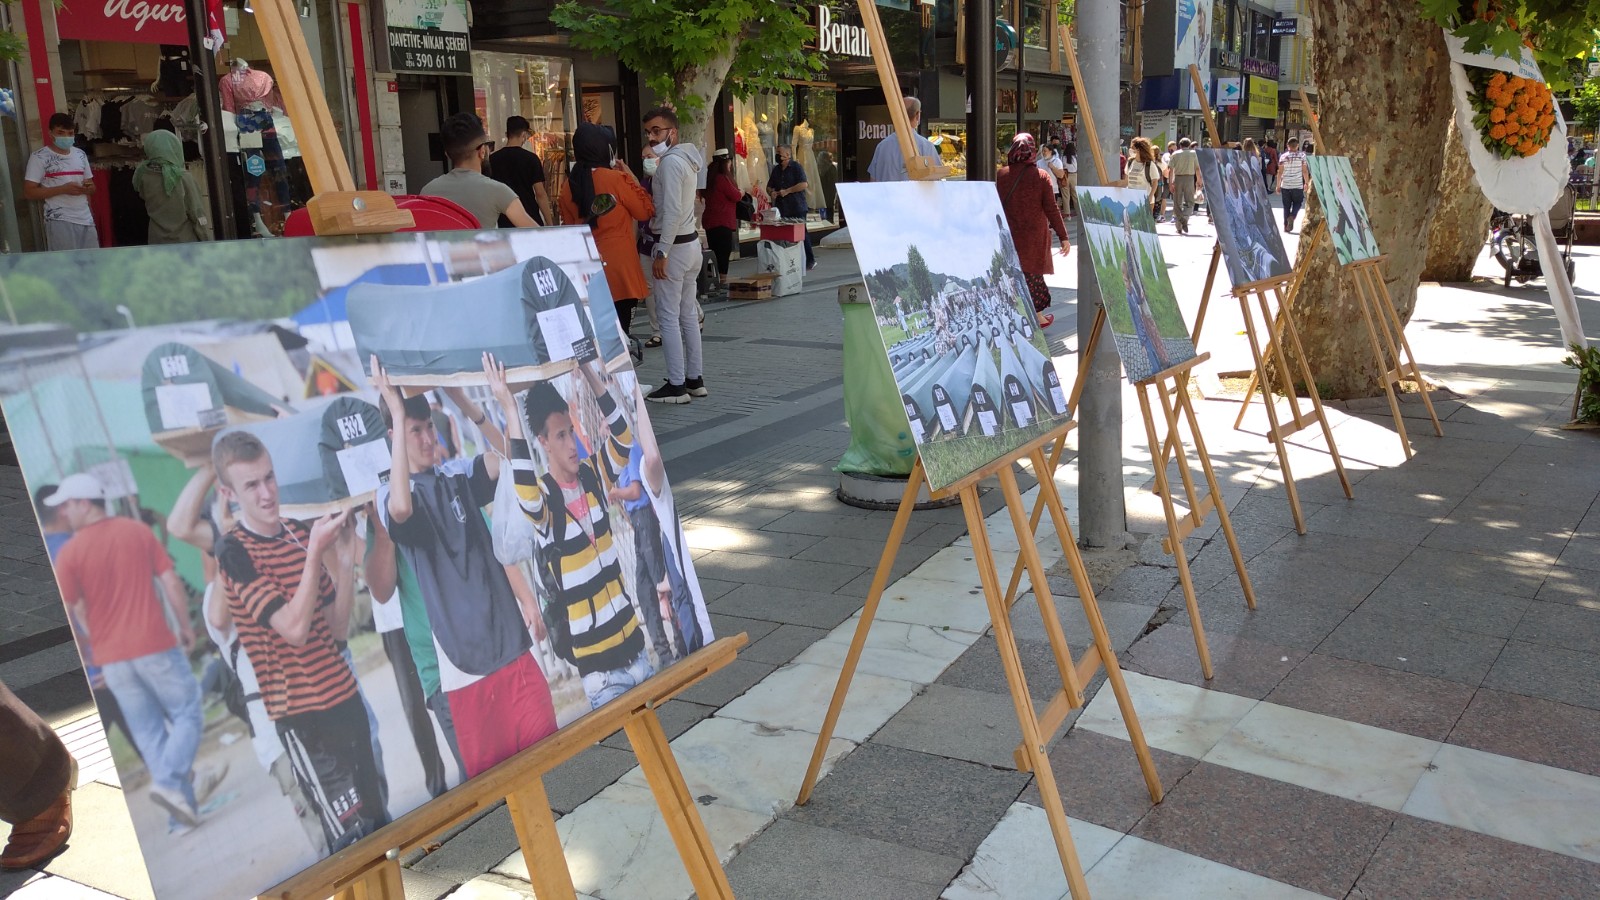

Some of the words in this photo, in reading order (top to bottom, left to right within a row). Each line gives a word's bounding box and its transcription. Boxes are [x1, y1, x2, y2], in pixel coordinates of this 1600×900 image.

[445, 35, 468, 53] ŞEKERİ
[415, 53, 433, 68] 390
[436, 55, 446, 69] 61
[448, 55, 457, 69] 11
[536, 269, 555, 294] 533
[342, 414, 363, 439] 532
